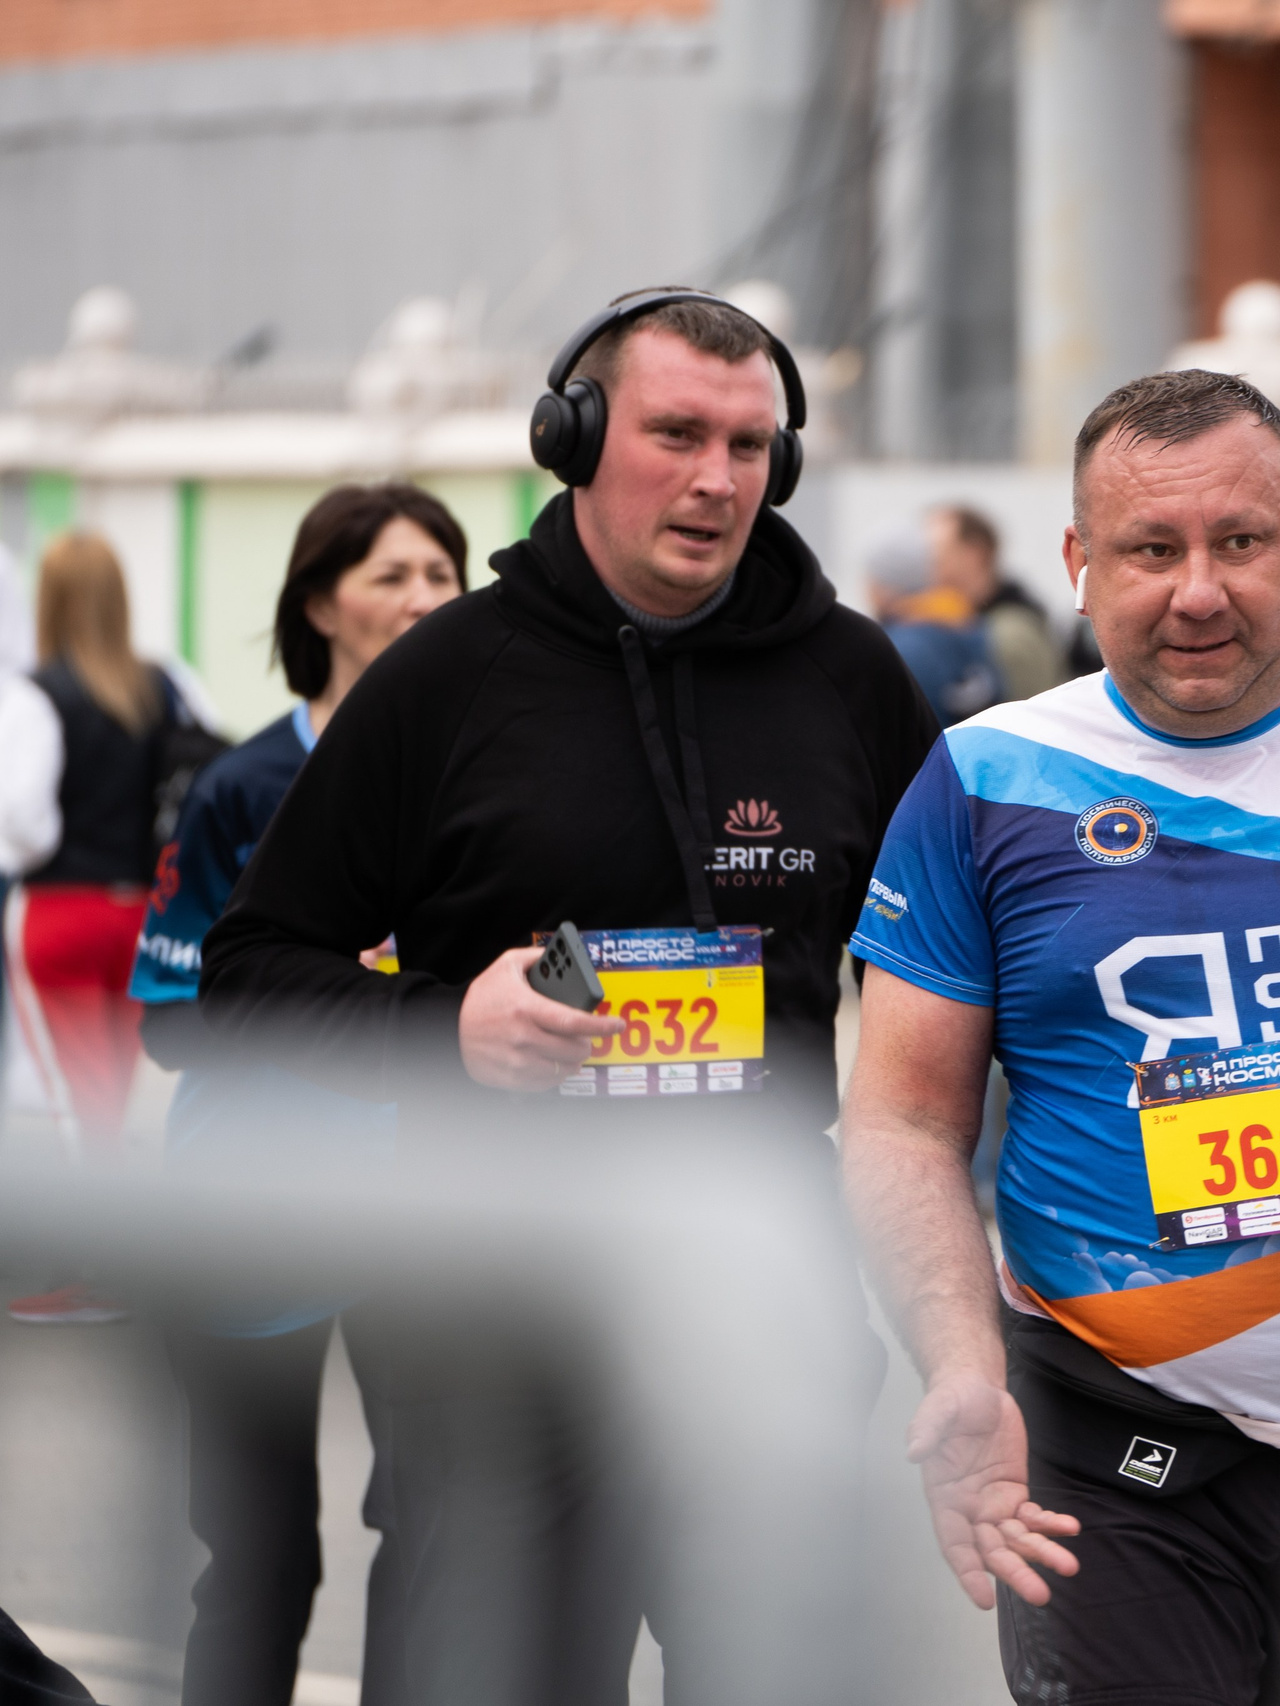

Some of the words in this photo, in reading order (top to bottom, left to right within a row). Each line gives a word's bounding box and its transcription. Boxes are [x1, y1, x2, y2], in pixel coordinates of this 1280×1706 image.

[1080, 799, 1154, 827] КОСМИЧЕСКИЙ
[1080, 832, 1154, 864] ПОЛУМАРАФОН
[704, 847, 774, 870] ERIT
[779, 848, 816, 873] GR
[618, 937, 695, 950] ПРОСТО
[602, 949, 696, 963] КОСМОС
[1094, 932, 1242, 1108] Я
[1212, 1061, 1227, 1073] Я
[1153, 1115, 1160, 1125] 3
